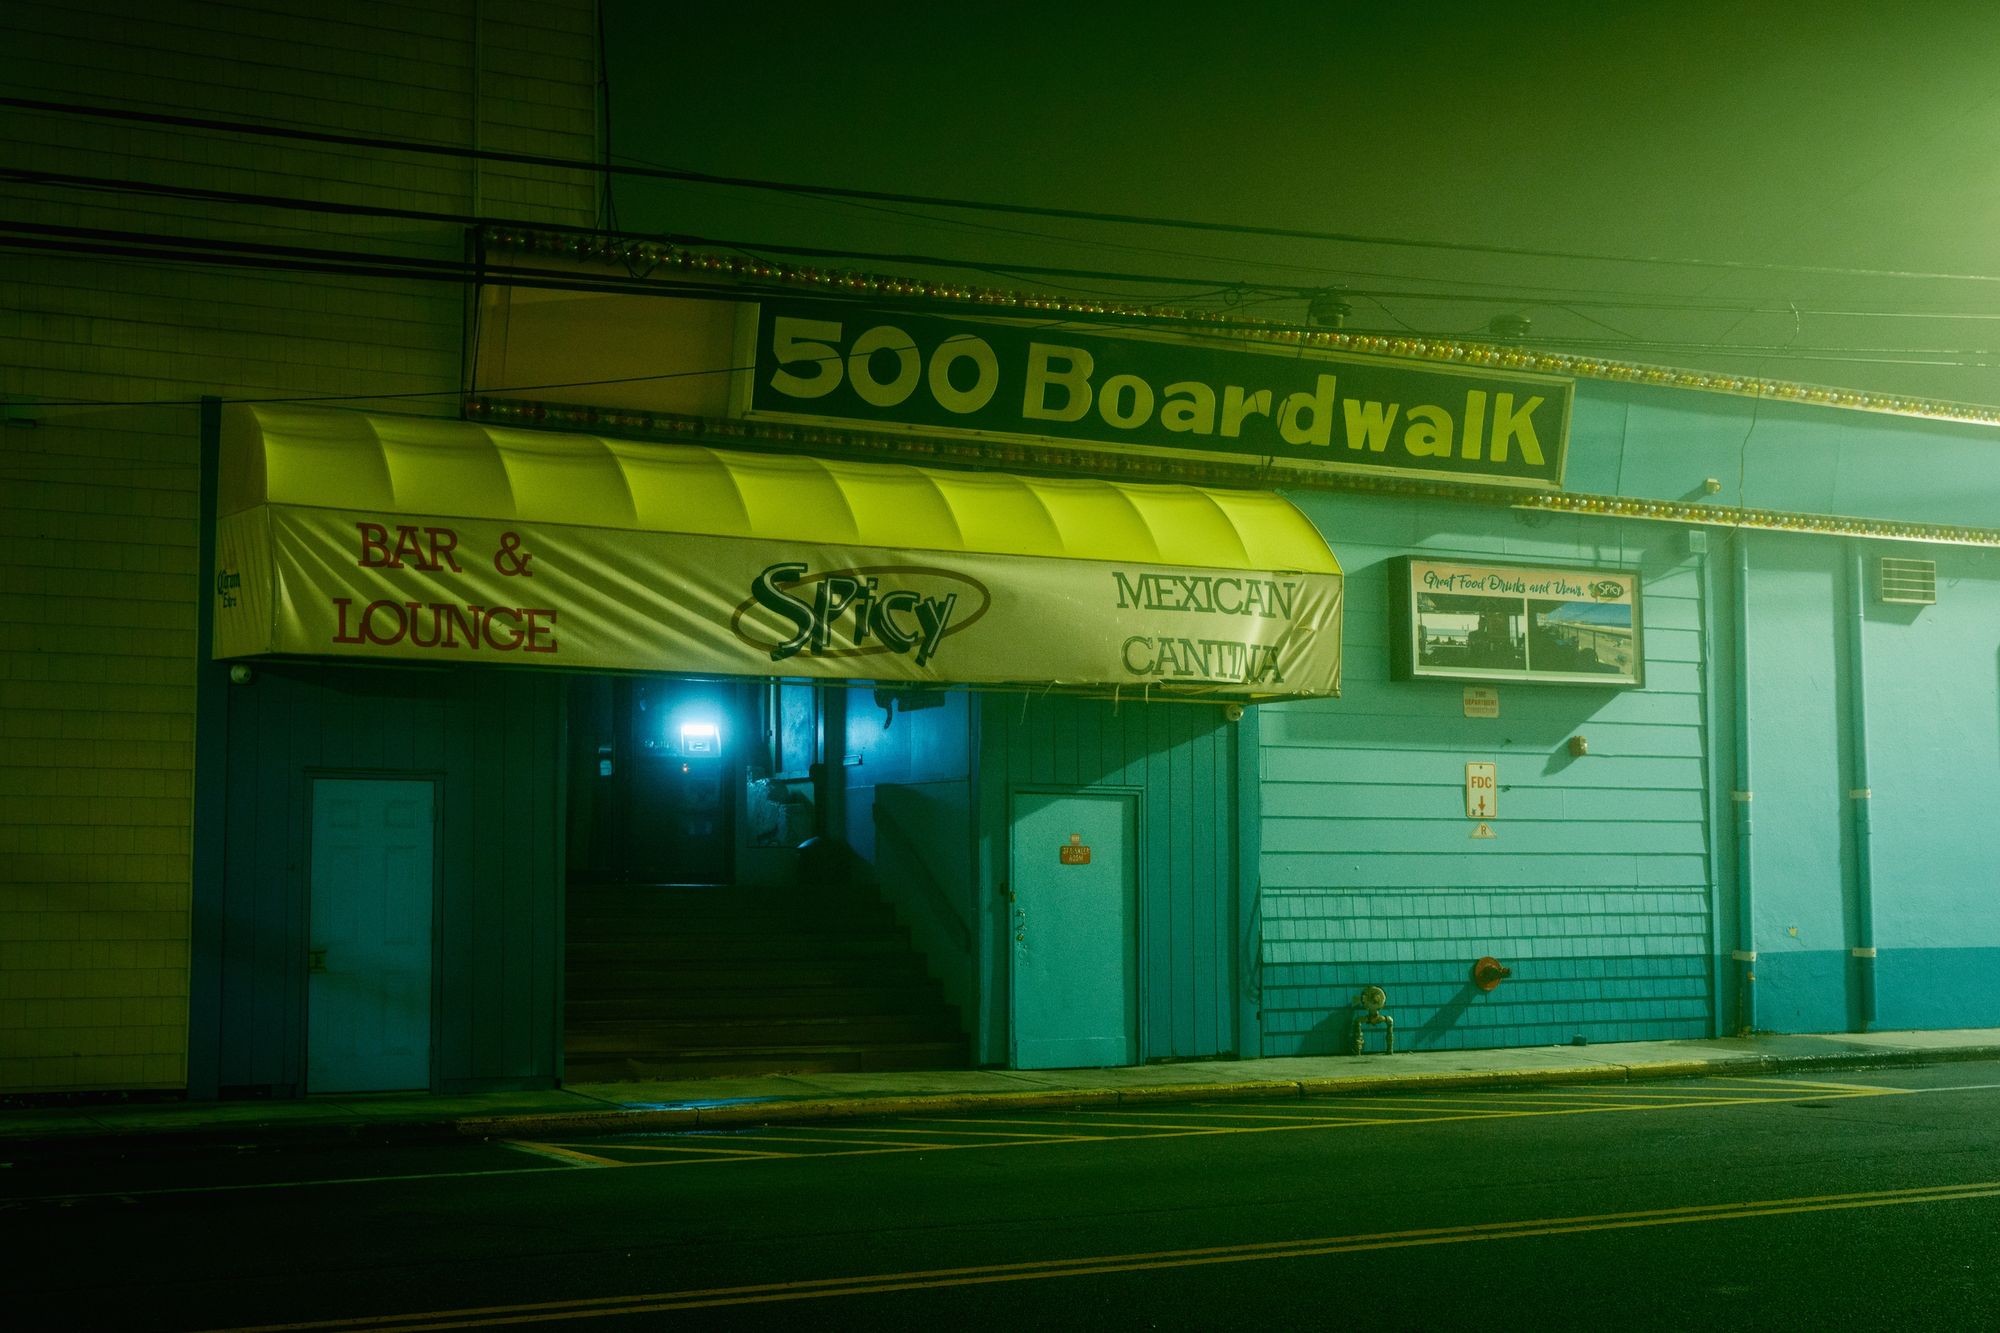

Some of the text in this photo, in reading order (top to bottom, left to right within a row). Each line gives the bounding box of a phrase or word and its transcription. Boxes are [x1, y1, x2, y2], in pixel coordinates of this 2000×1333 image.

[770, 316, 999, 414] 500
[356, 522, 533, 577] BAR &
[1112, 571, 1296, 620] MEXICAN
[1423, 570, 1456, 591] Great
[1457, 574, 1486, 591] Food
[1488, 574, 1526, 593] Drinks
[1529, 579, 1551, 595] and
[333, 598, 558, 653] LOUNGE
[1120, 635, 1285, 683] CANTINA
[1471, 776, 1492, 789] FDC
[1480, 825, 1487, 835] R
